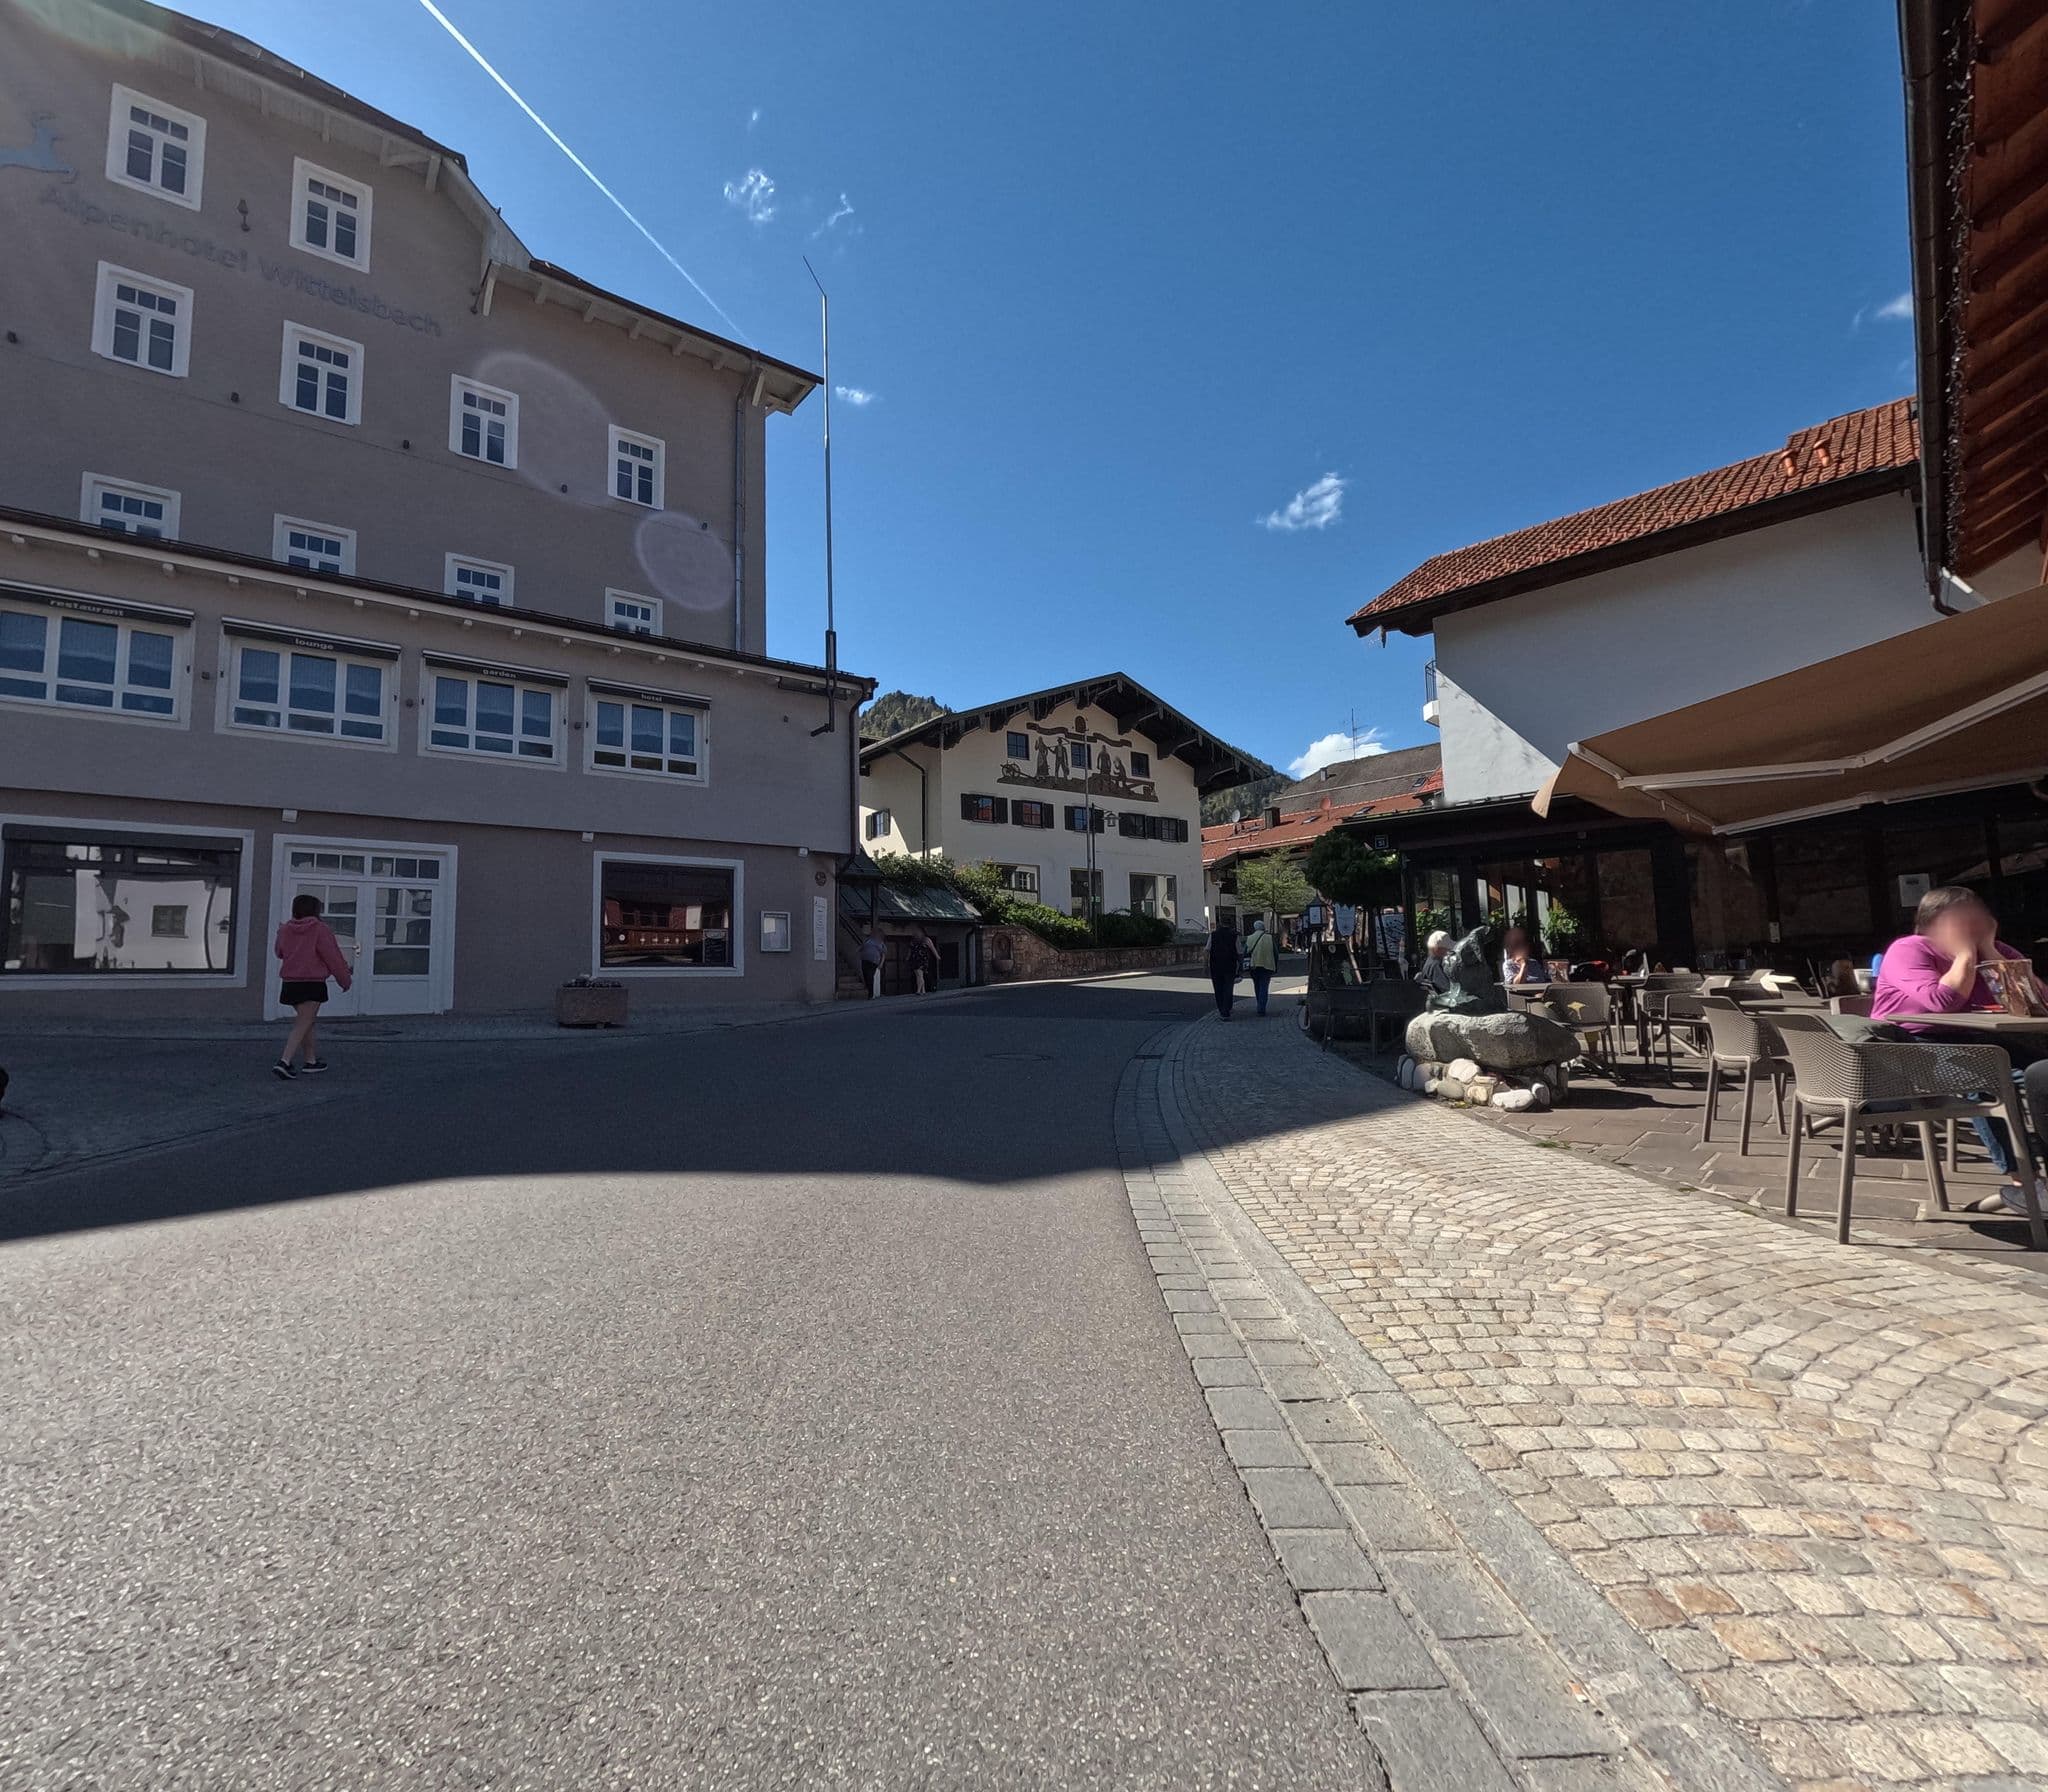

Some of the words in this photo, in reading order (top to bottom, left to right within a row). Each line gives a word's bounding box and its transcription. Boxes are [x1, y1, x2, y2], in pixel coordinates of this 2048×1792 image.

[40, 185, 248, 272] Alpenhotel
[258, 255, 442, 337] Wittelsbach
[50, 600, 124, 616] restaurant
[295, 638, 334, 650] lounge
[482, 669, 517, 679] garden
[641, 692, 663, 702] hotel
